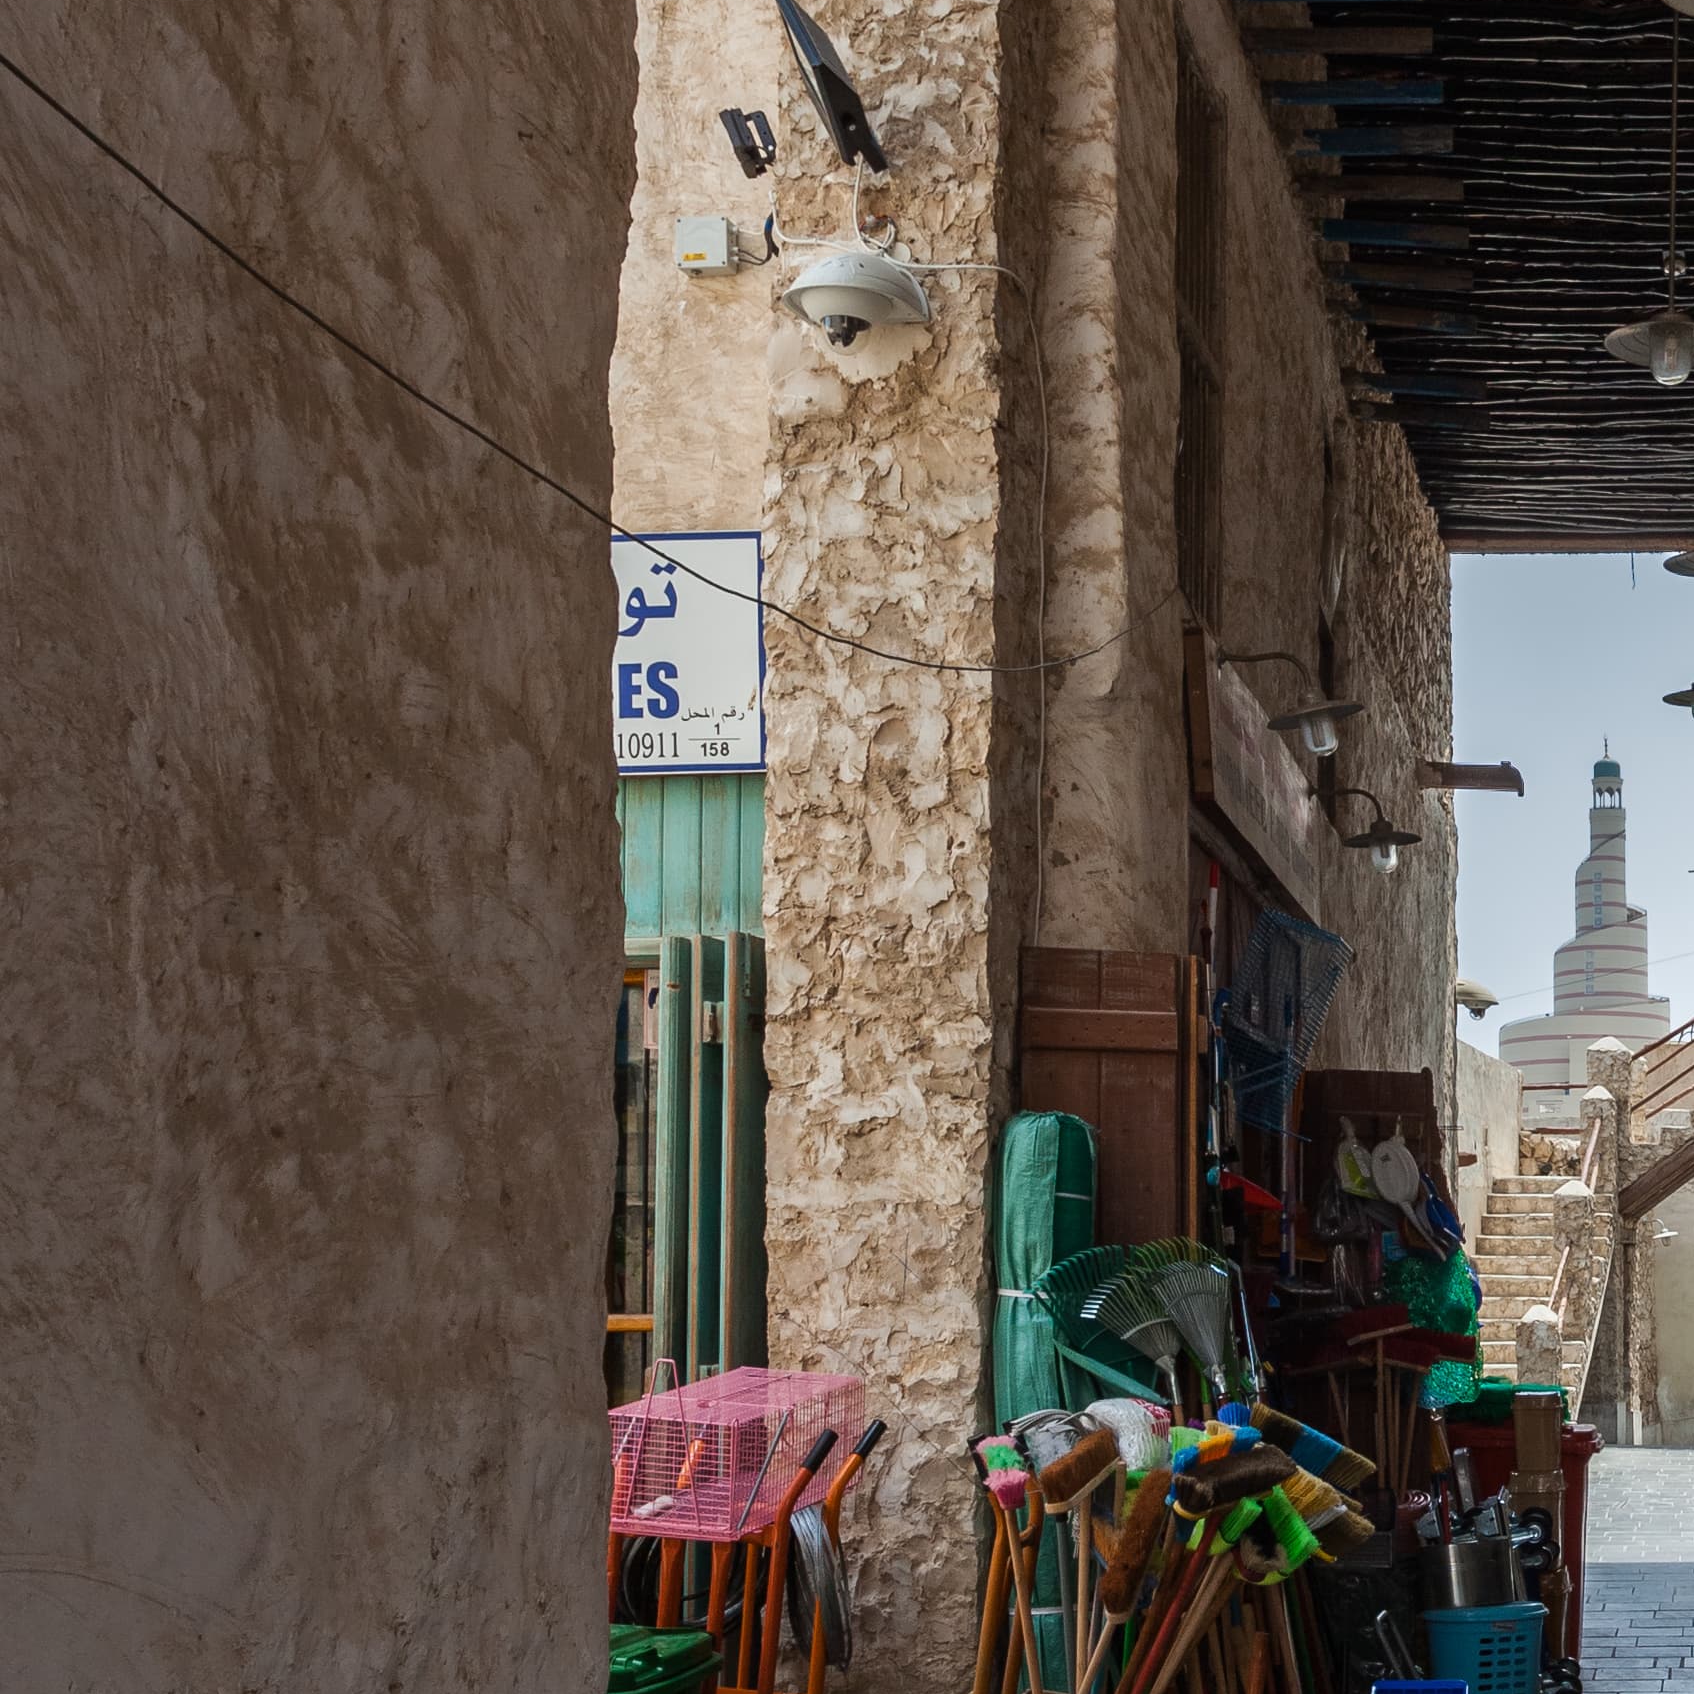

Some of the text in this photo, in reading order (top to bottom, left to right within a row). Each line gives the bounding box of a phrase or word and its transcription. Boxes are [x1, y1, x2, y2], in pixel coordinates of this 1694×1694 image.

[618, 661, 680, 719] ES
[714, 723, 721, 736] 1
[700, 742, 730, 757] 158
